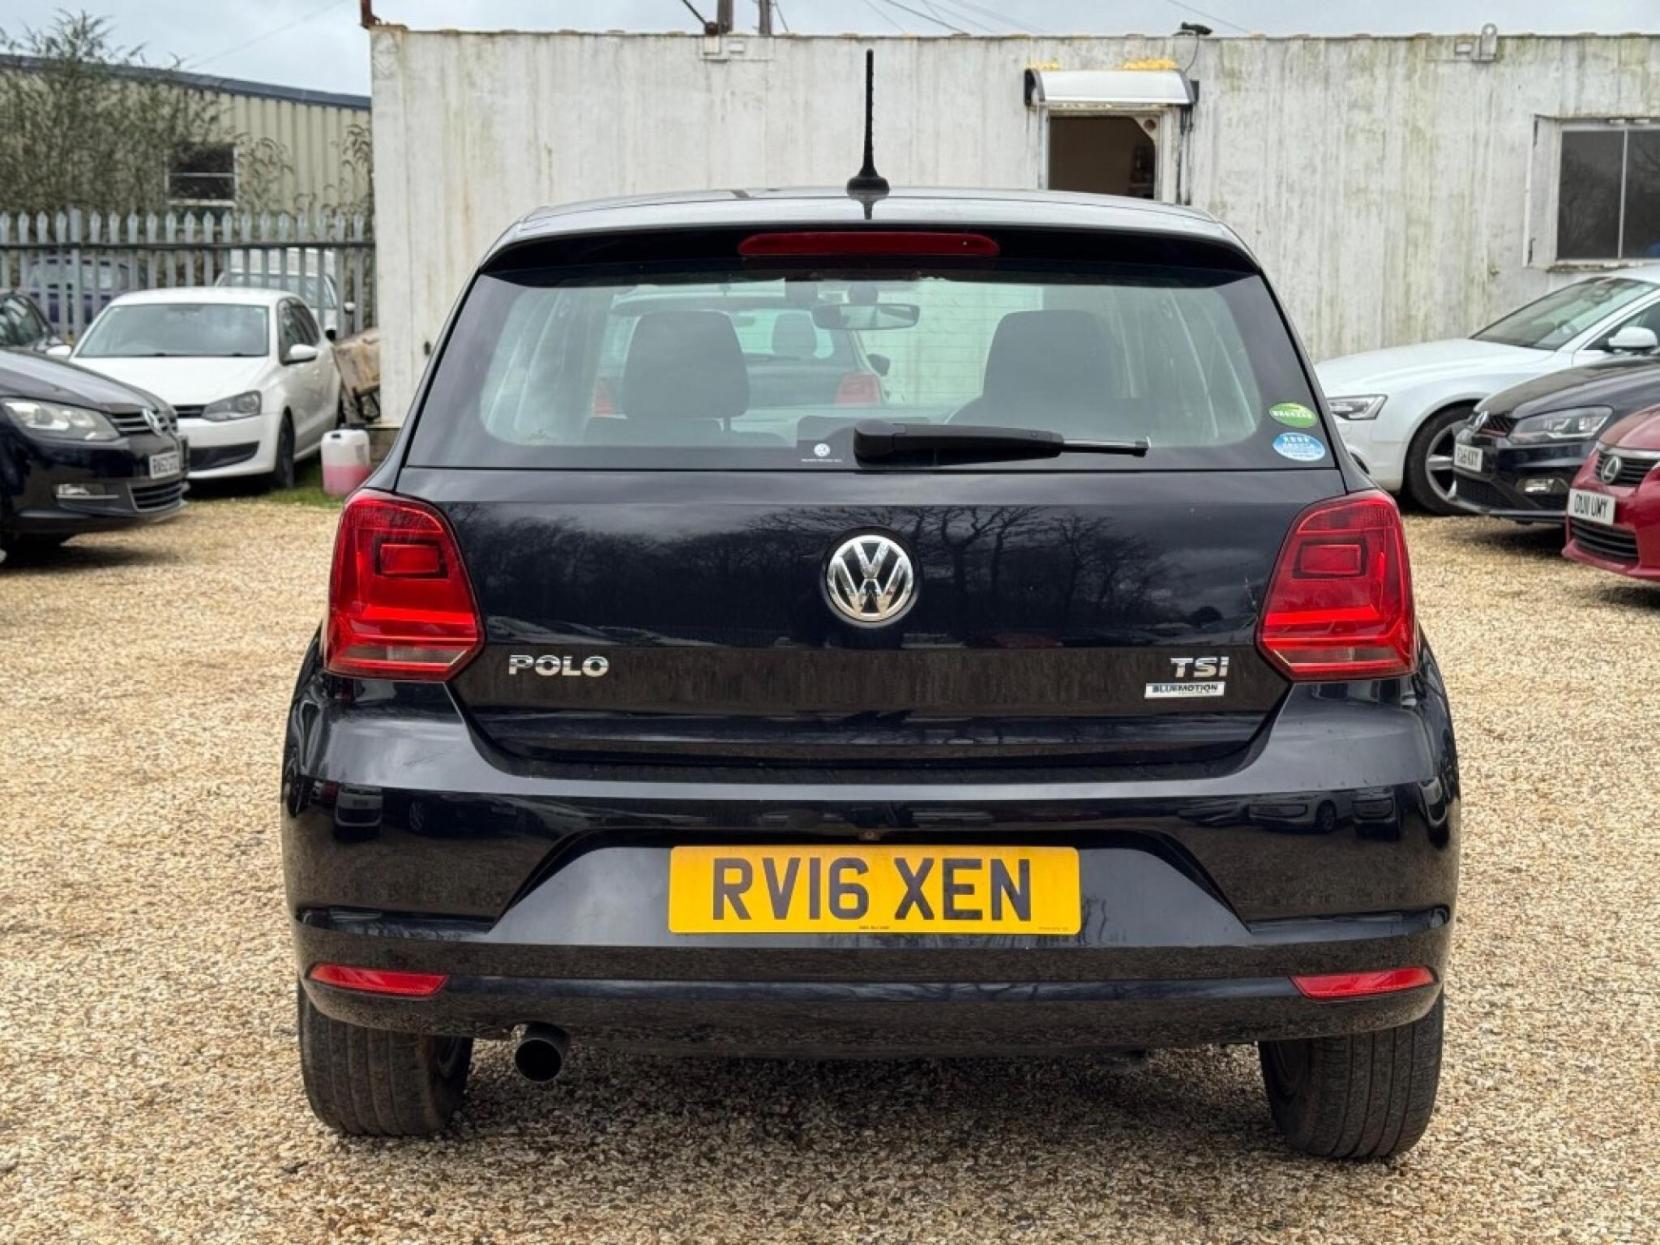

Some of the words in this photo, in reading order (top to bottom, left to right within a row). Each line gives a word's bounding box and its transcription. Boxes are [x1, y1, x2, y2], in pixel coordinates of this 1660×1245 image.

[508, 654, 609, 677] POLO
[713, 857, 870, 920] RV16
[894, 858, 1032, 921] XEN
